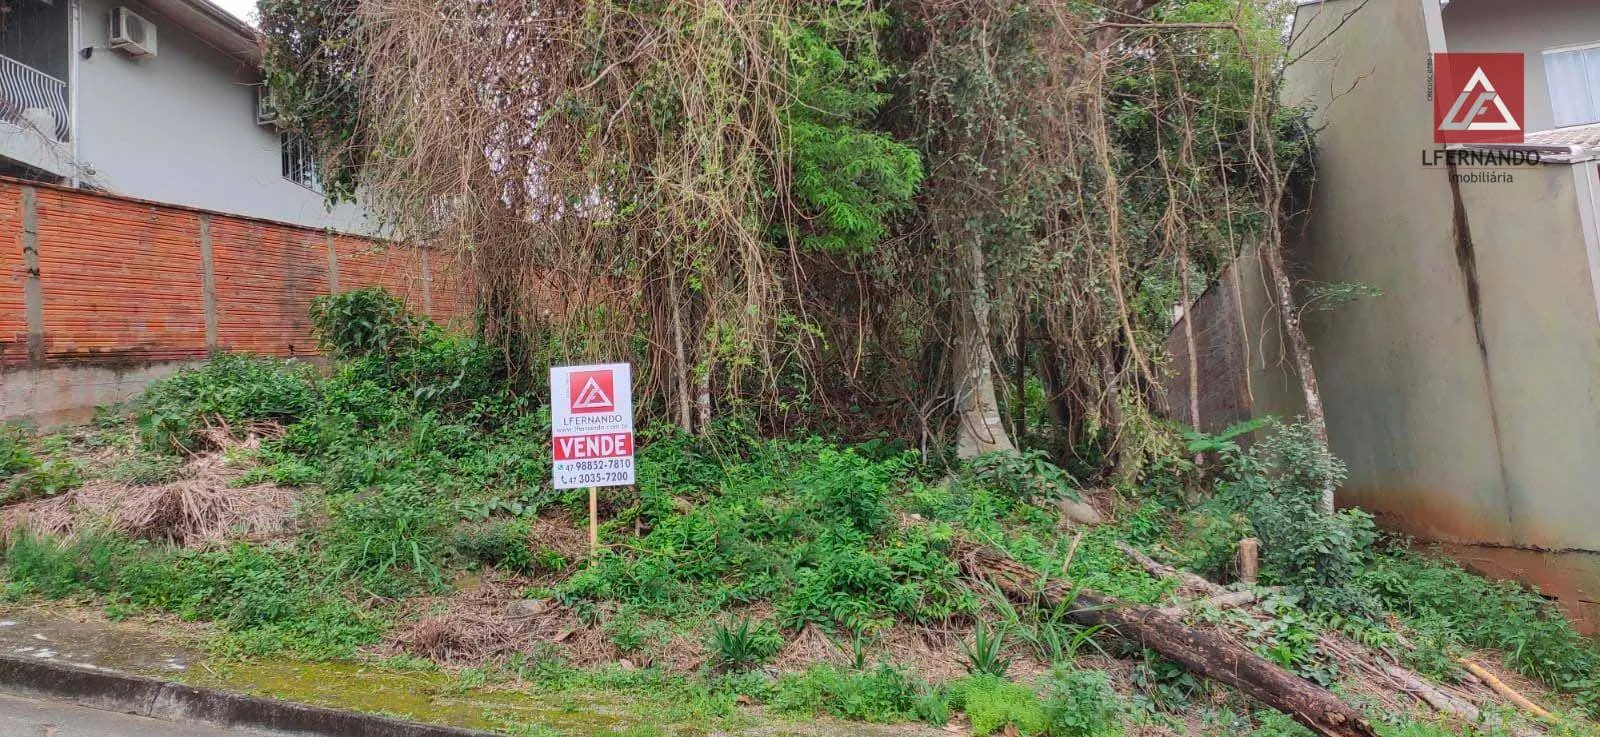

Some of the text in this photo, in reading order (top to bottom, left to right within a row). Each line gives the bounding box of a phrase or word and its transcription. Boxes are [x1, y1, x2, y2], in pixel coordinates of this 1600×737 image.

[563, 415, 622, 426] LFERNANDO
[559, 435, 626, 458] VENDE
[566, 459, 631, 472] 47 98852-7810
[579, 472, 628, 484] 3035-7200
